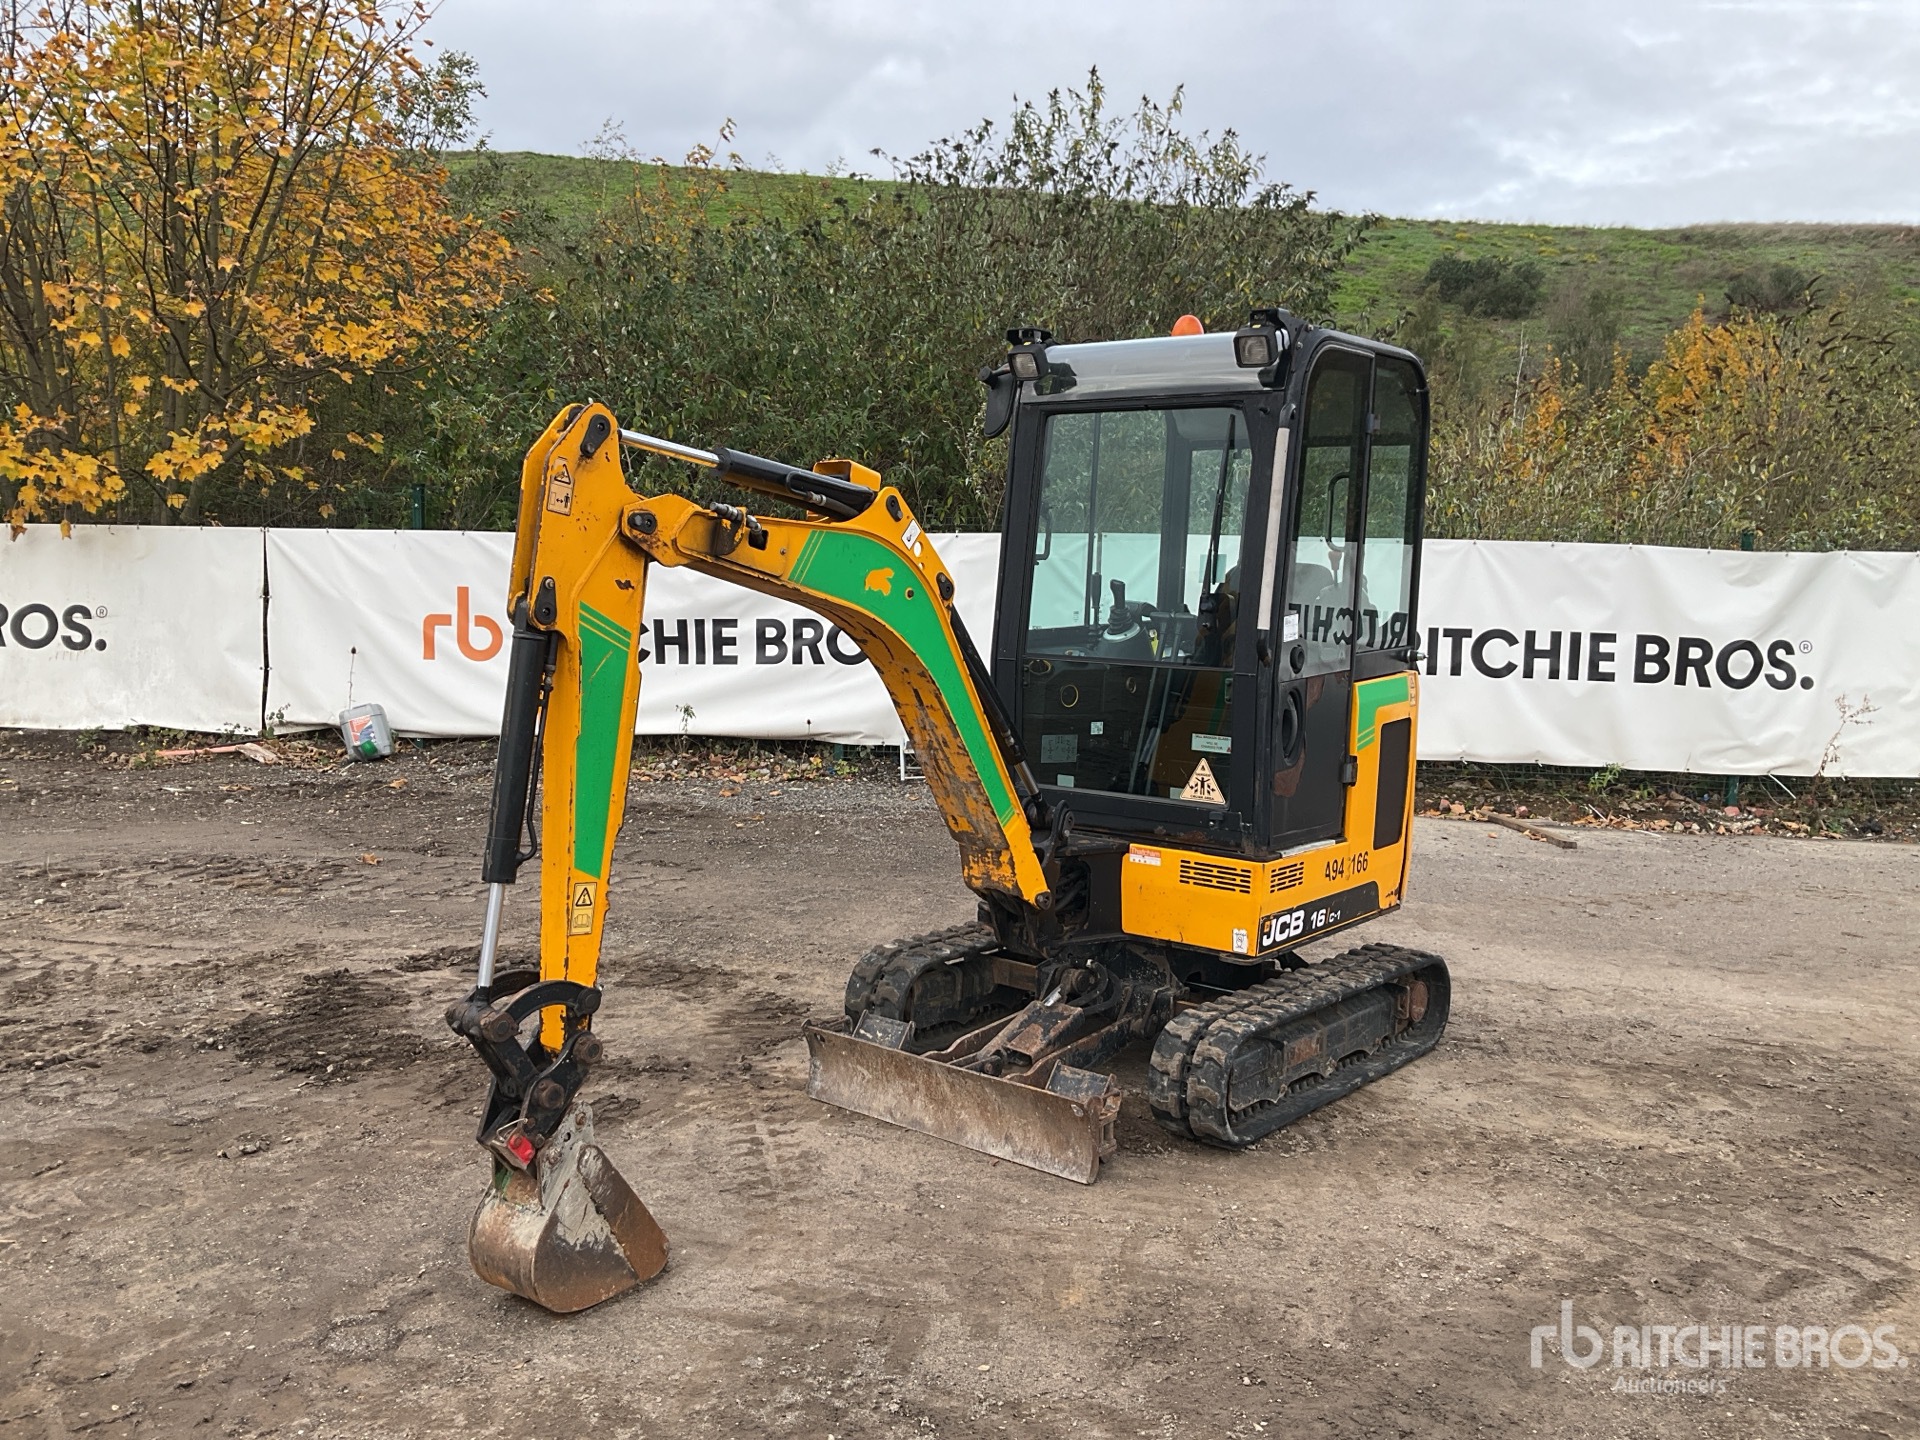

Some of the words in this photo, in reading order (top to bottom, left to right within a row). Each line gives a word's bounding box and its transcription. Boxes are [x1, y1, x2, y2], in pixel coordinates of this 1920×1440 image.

[423, 586, 503, 661] rb
[1415, 627, 1617, 682] ITCHIE
[1262, 909, 1305, 946] JCB
